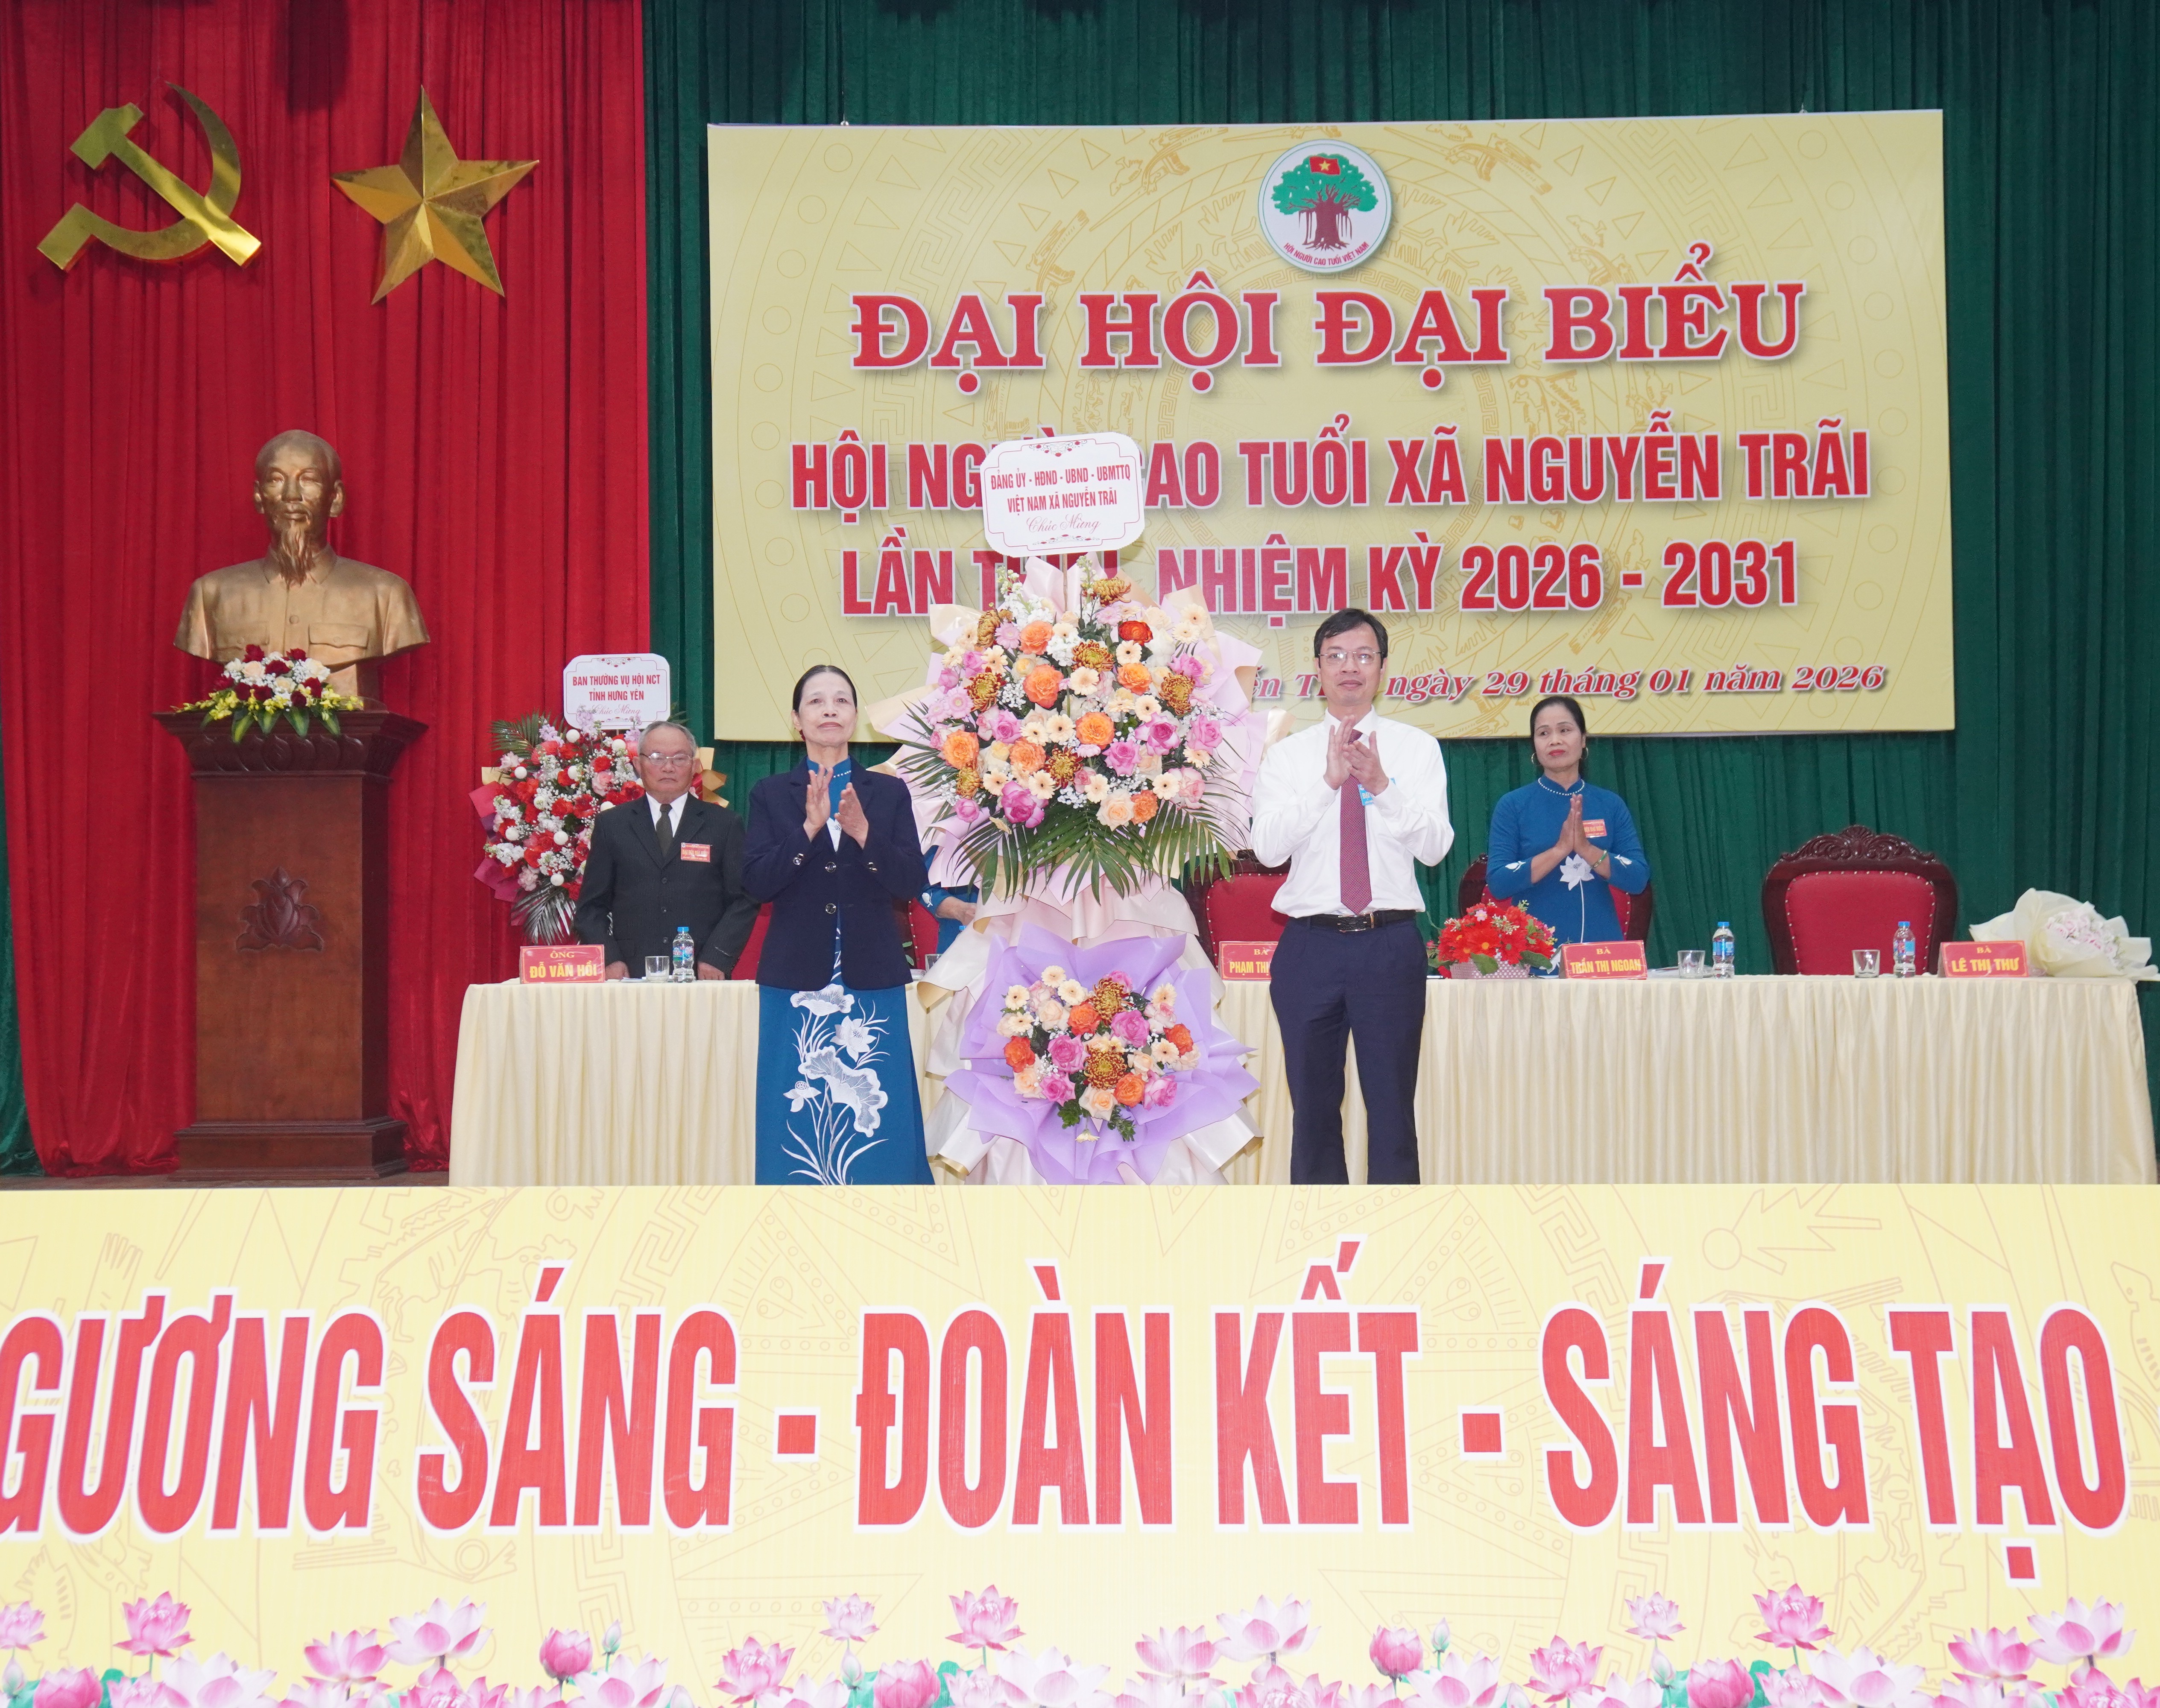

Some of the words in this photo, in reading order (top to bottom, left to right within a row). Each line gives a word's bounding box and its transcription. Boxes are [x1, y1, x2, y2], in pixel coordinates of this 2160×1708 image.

[1356, 241, 1370, 255] NAM
[852, 295, 1042, 392] ĐẠI
[1080, 272, 1278, 390] HỘI
[1316, 290, 1507, 387] ĐẠI
[1545, 243, 1803, 360] BIỂU
[793, 430, 886, 522] HỘI
[1139, 442, 1219, 508] AO
[1240, 414, 1366, 505] TUỔI
[1389, 427, 1465, 503] XÃ
[1486, 412, 1719, 501] NGUYỄN
[1739, 419, 1867, 497] TRÃI
[991, 470, 1013, 489] ĐẢNG
[1015, 468, 1025, 488] ỦY
[1034, 470, 1057, 485] HĐND
[1065, 468, 1088, 483] UBND
[1097, 464, 1130, 481] UBMTTQ
[1007, 494, 1024, 515] VIỆT
[1027, 495, 1047, 511] NAM
[1049, 492, 1060, 509] XÃ
[1062, 487, 1096, 508] NGUYỄN
[1098, 487, 1117, 505] TRÃI
[1027, 516, 1057, 532] Chúc
[843, 528, 952, 614] LẦN
[1159, 533, 1346, 627] NHIỆM
[1370, 532, 1440, 610] KỲ
[1462, 544, 1601, 609] 2026
[1623, 574, 1642, 585] -
[1664, 541, 1794, 605] 2031
[573, 676, 587, 685] BAN
[590, 673, 618, 685] THƯỜNG
[621, 676, 629, 687] VỤ
[632, 673, 644, 686] HỘI
[647, 675, 660, 684] NCT
[1387, 669, 1472, 700] ngày
[1483, 673, 1528, 693] 29
[1540, 667, 1639, 697] tháng
[1650, 670, 1688, 690] 01
[1705, 666, 1780, 690] năm
[1792, 667, 1882, 688] 2026
[589, 688, 605, 701] TỈNH
[608, 690, 627, 700] HƯNG
[631, 689, 644, 700] YÊN
[530, 962, 546, 978] ĐỖ
[550, 963, 573, 977] VĂN
[1230, 962, 1253, 975] PHẠM
[1256, 962, 1269, 976] THỊ
[1595, 961, 1610, 974] THỊ
[1611, 959, 1641, 971] NGOAN
[1952, 958, 1967, 972] LÊ
[1994, 957, 2020, 971] THƯ
[0, 1295, 383, 1534] GƯƠNG
[418, 1268, 735, 1529] SÁNG
[778, 1415, 816, 1454] -
[856, 1266, 1171, 1527] ĐOÀN
[1216, 1242, 1418, 1524] KẾT
[1463, 1413, 1501, 1452] -
[1543, 1264, 1869, 1527] SÁNG
[1890, 1309, 2125, 1579] TẠO
